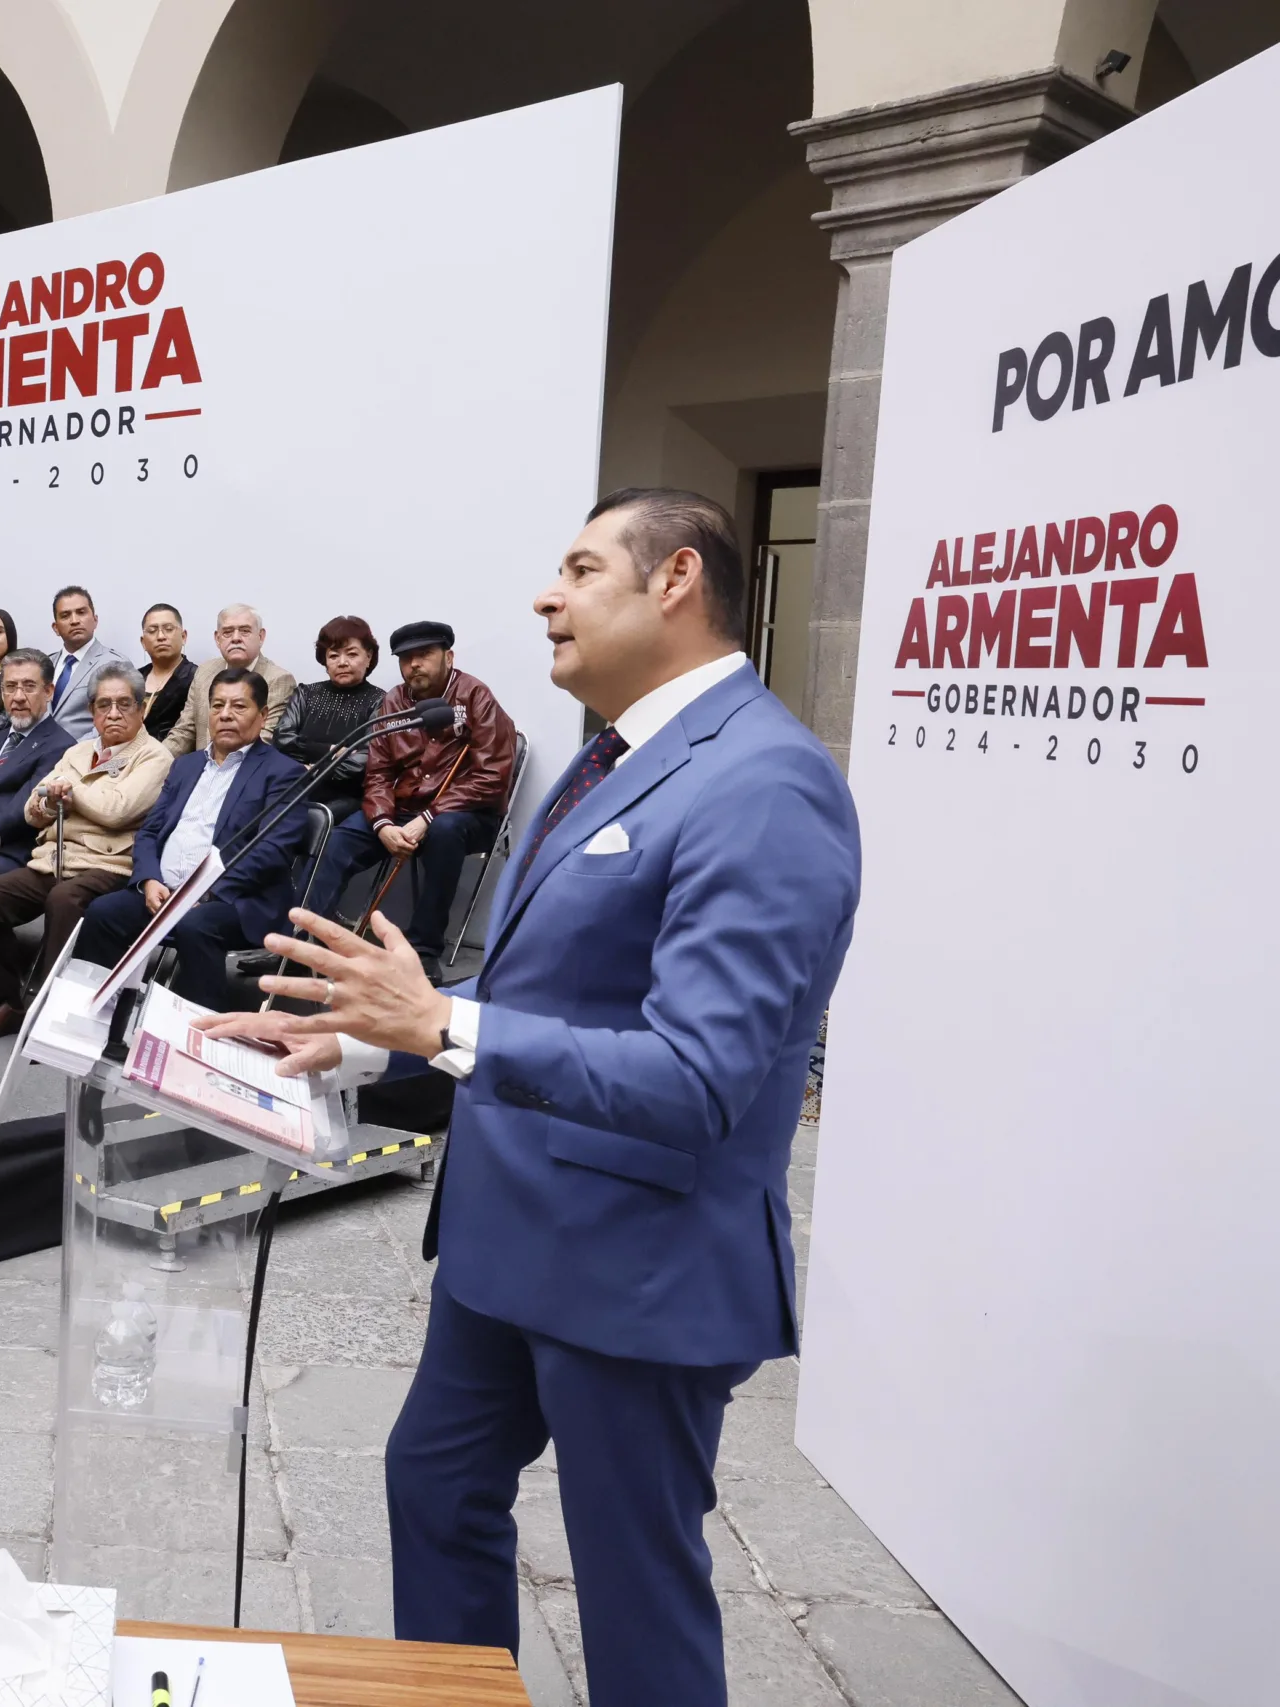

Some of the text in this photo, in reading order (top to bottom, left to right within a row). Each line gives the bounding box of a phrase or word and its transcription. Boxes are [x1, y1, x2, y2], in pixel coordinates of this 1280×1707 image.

[991, 315, 1116, 434] POR
[925, 503, 1180, 590] ALEJANDRO
[894, 572, 1210, 669] ARMENTA
[927, 683, 1141, 723] GOBERNADOR
